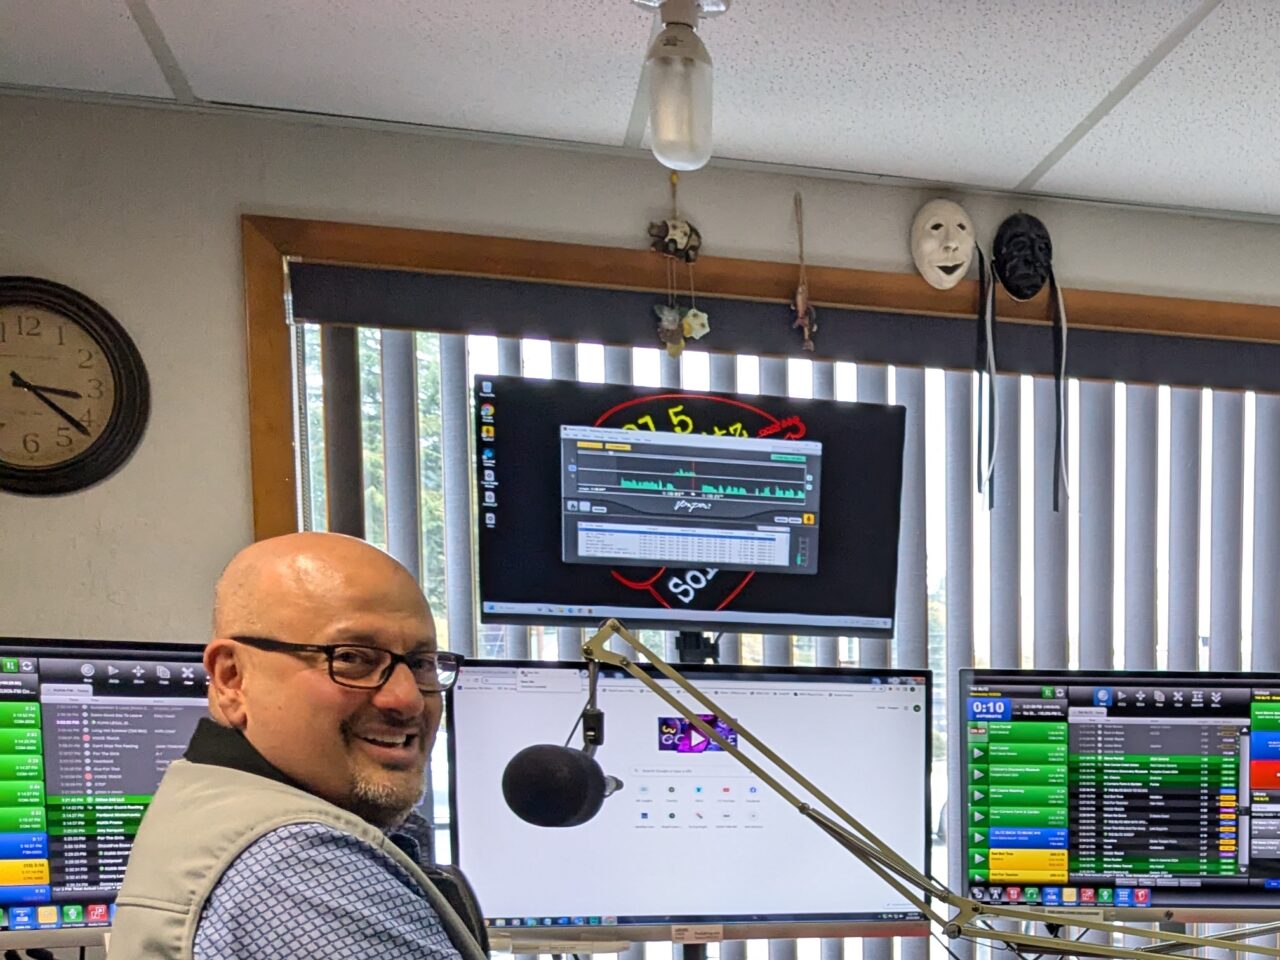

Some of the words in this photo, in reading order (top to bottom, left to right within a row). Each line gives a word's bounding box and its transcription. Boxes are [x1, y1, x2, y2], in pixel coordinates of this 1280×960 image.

[17, 316, 41, 336] 12
[57, 325, 65, 346] 1
[78, 349, 93, 369] 2
[88, 379, 103, 399] 3
[79, 408, 94, 428] 4
[23, 433, 40, 454] 6
[56, 427, 73, 447] 5
[973, 702, 1005, 713] 0:10
